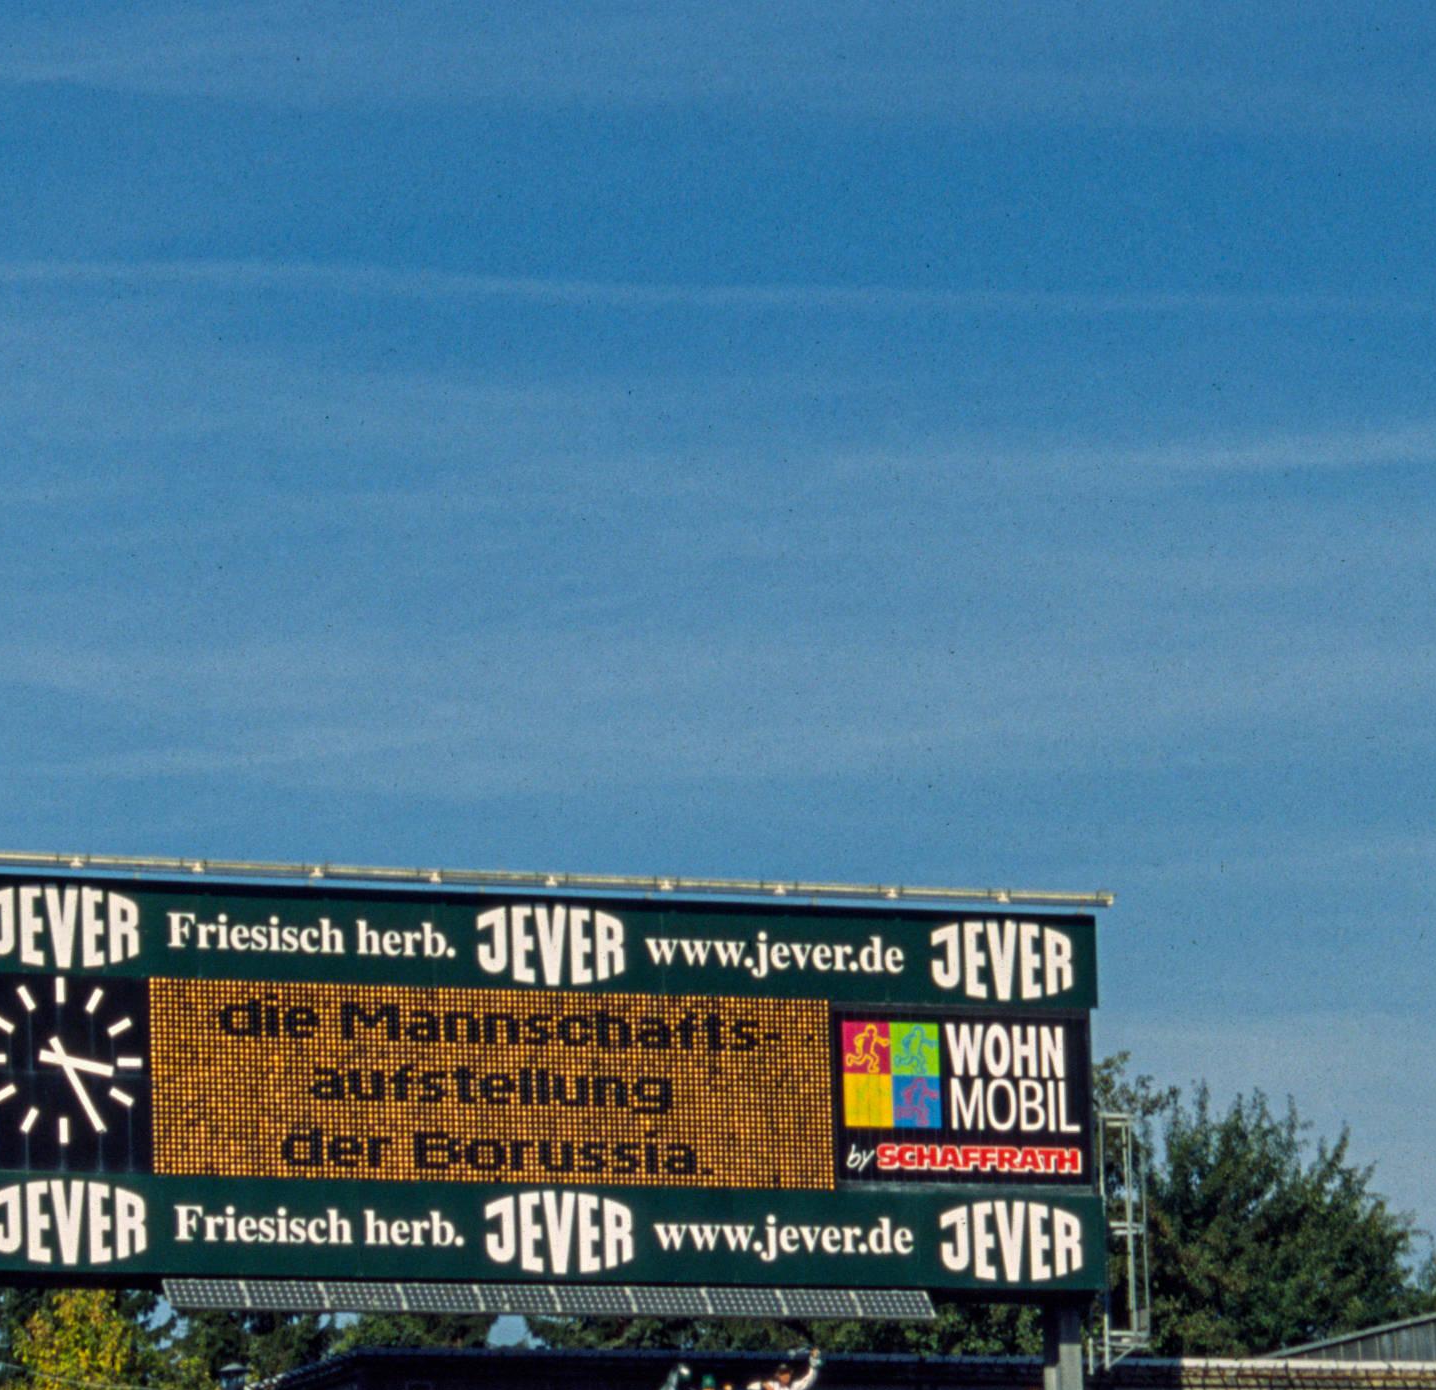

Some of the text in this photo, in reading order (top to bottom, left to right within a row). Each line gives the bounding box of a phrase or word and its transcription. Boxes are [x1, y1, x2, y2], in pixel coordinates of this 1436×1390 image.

[166, 911, 345, 957] Friesisch
[355, 920, 457, 960] herb.
[477, 903, 627, 987] JEVER
[644, 931, 906, 978] www.jever.de
[930, 919, 1075, 1001] JEVER
[219, 992, 319, 1039] die
[945, 1022, 1065, 1079] WOHN
[311, 1060, 673, 1115] aufstellung
[950, 1077, 1081, 1134] MOBIL
[281, 1127, 391, 1169] der
[846, 1143, 1083, 1174] by SCHAFFRATH
[173, 1203, 353, 1247] Friesisch
[363, 1210, 466, 1248] herb.
[485, 1190, 635, 1275] JEVER
[654, 1215, 915, 1262] www.jever.de
[939, 1200, 1084, 1283] JEVER
